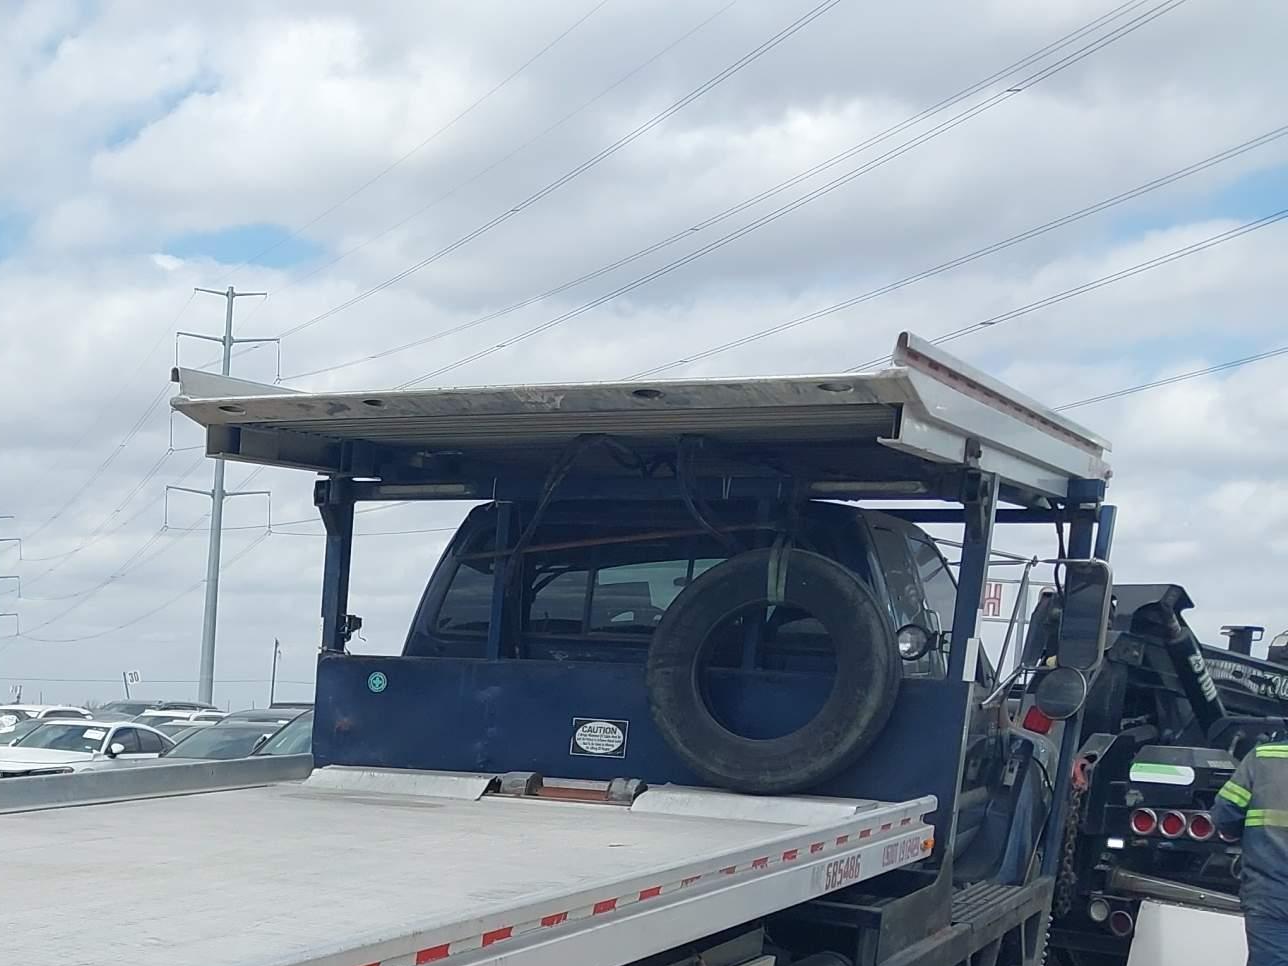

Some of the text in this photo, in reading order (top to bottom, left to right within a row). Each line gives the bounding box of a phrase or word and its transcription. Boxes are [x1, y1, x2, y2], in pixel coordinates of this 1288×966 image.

[128, 671, 139, 683] 30
[582, 725, 617, 735] CAUTION
[824, 854, 861, 891] 685486
